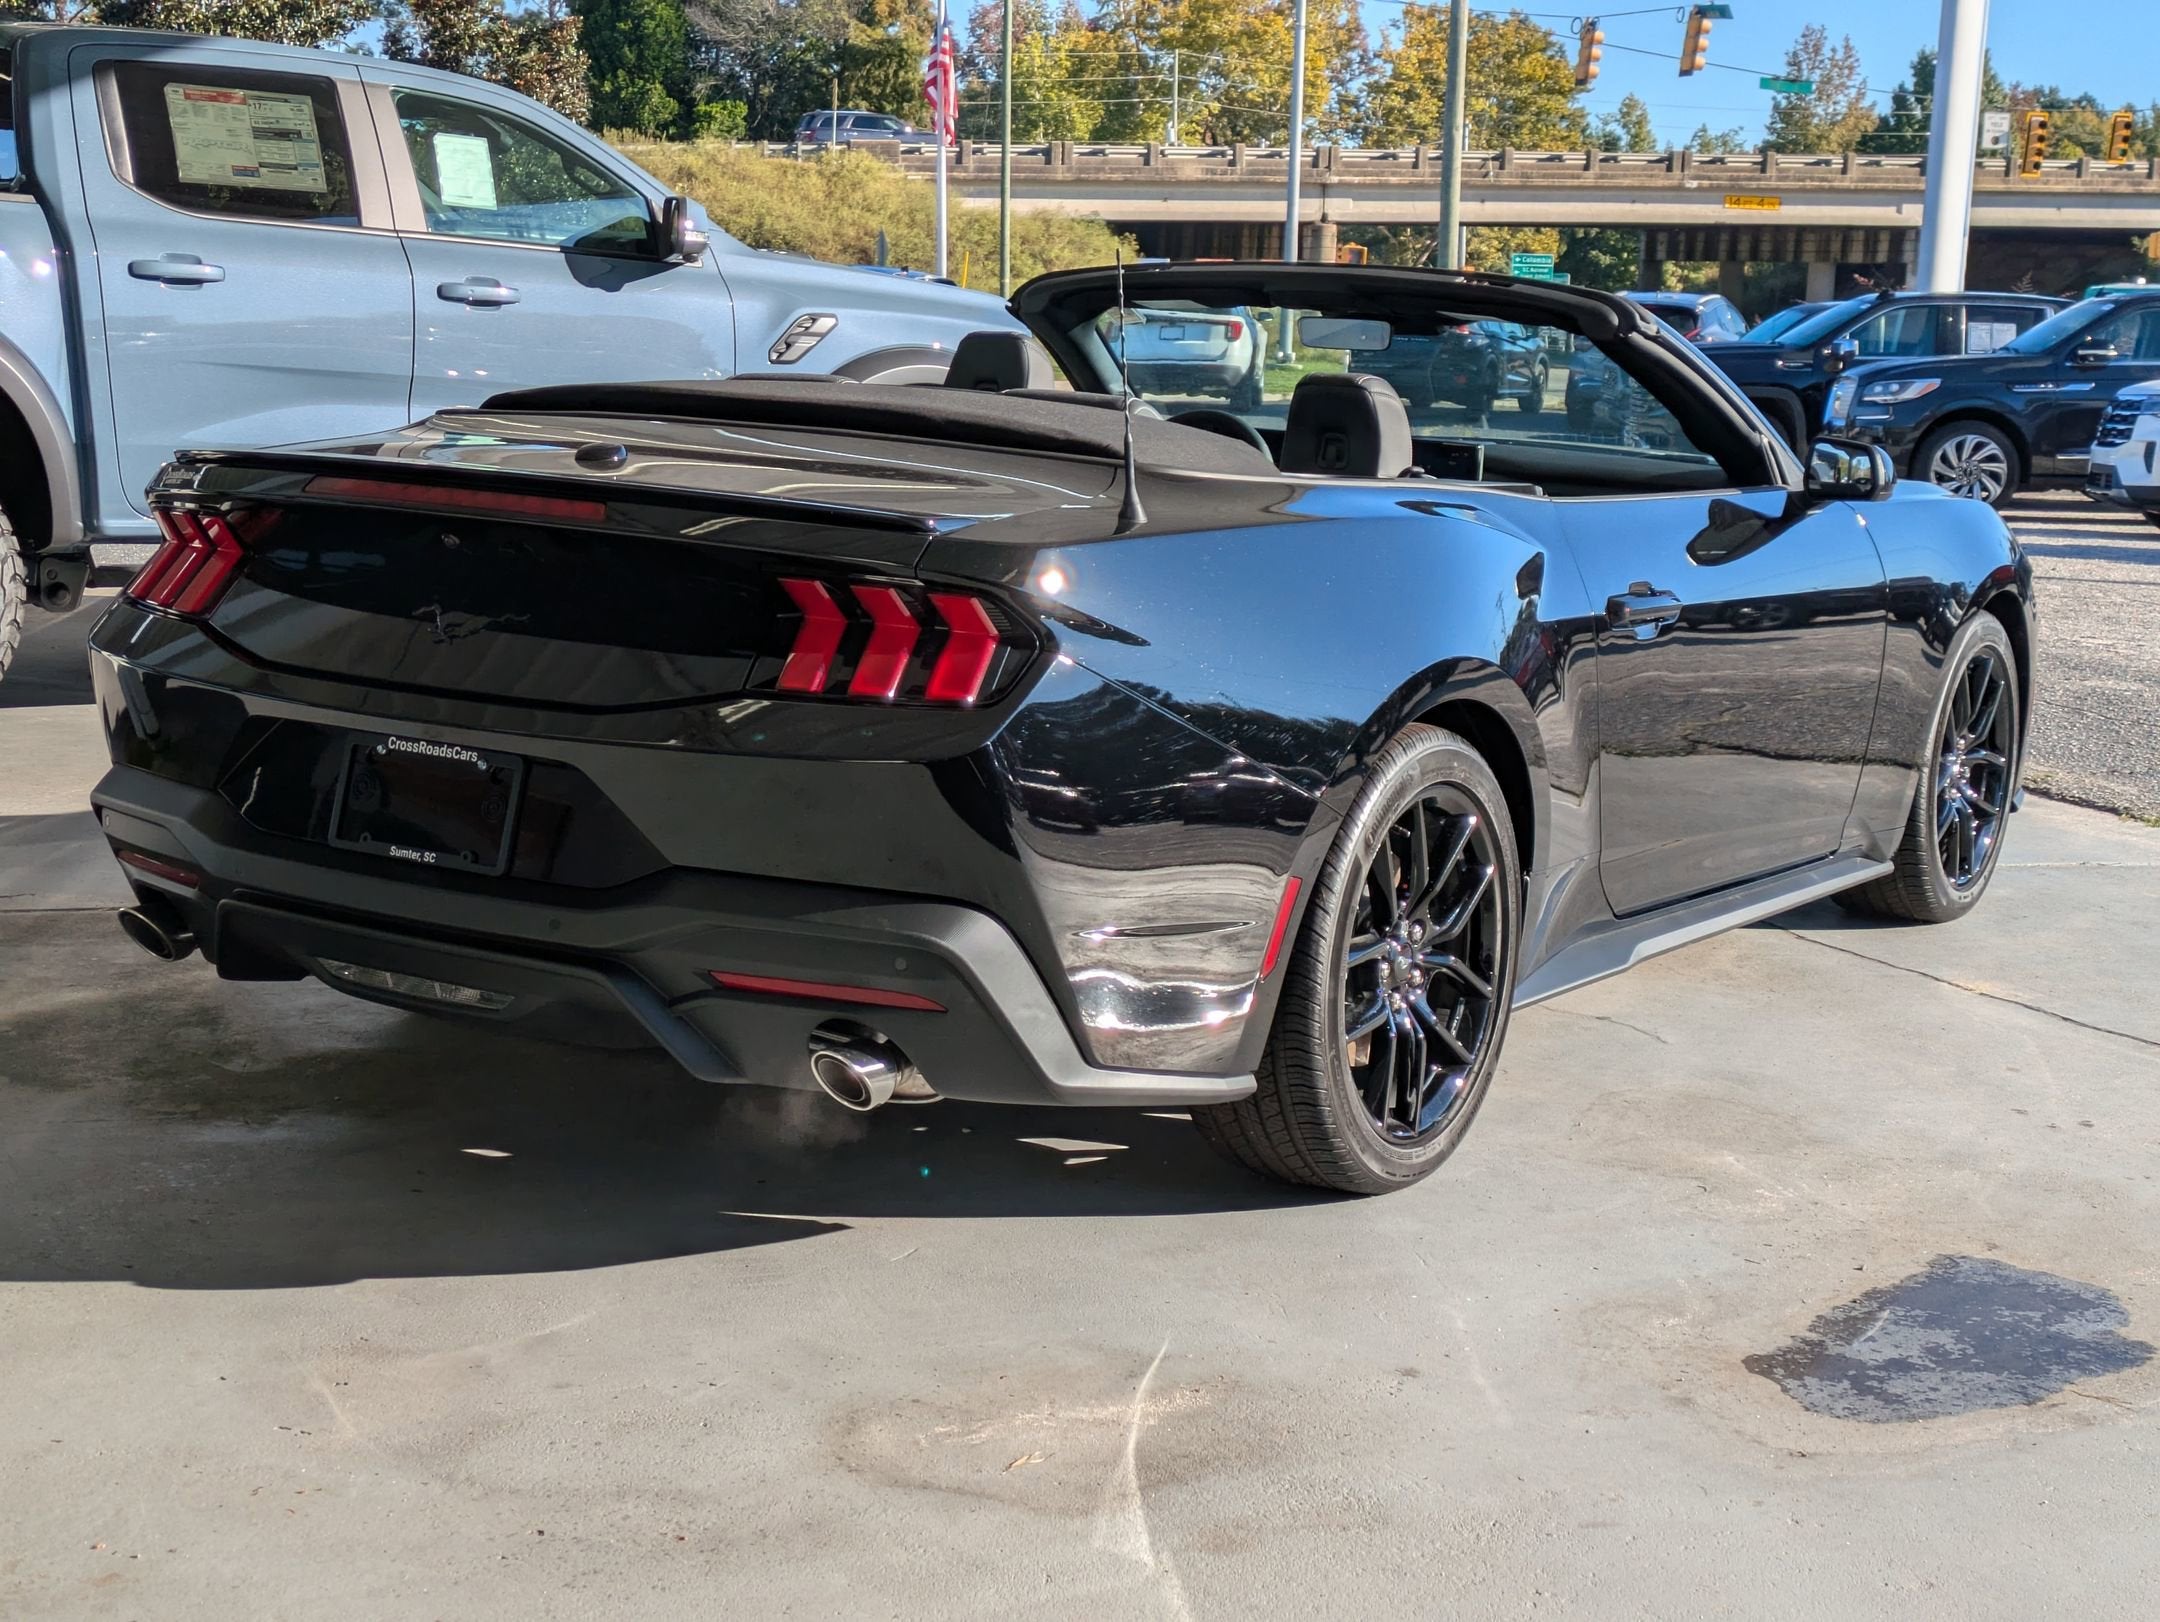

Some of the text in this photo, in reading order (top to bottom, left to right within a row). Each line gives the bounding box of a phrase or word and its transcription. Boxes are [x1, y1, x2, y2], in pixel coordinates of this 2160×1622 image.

[1729, 197, 1740, 207] 14
[1757, 198, 1765, 208] 4
[388, 736, 479, 762] CrossRoadsCars
[390, 845, 437, 863] Sumter, SC
